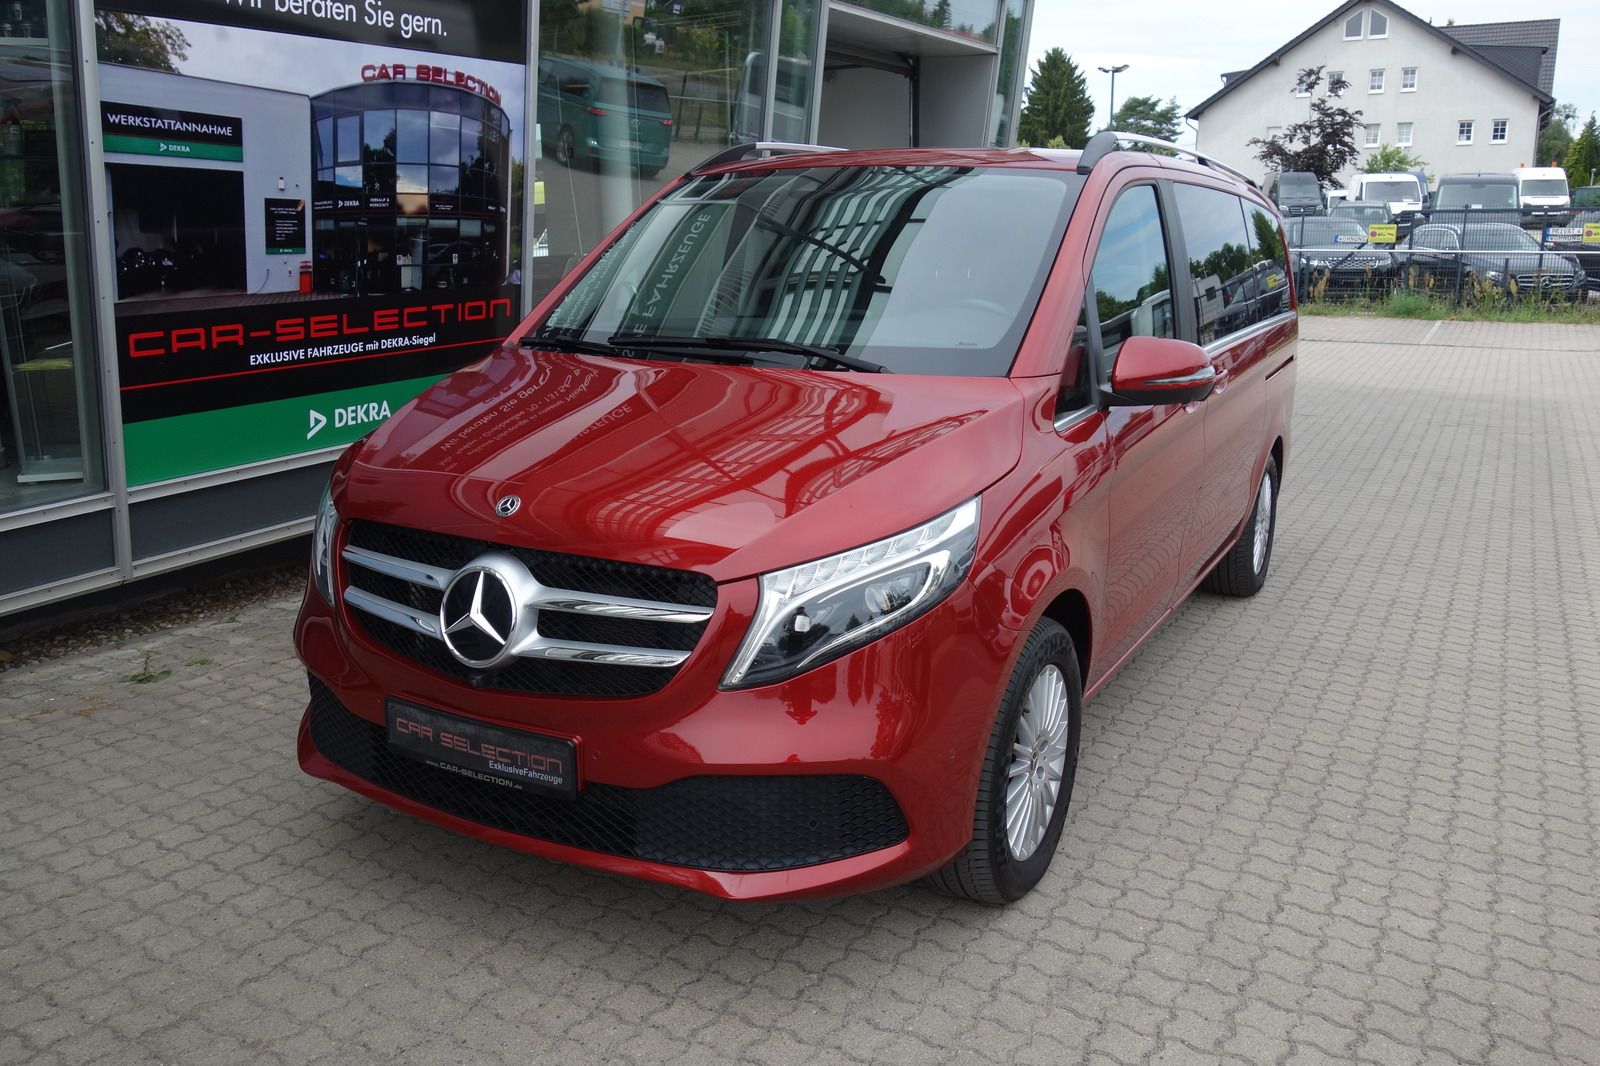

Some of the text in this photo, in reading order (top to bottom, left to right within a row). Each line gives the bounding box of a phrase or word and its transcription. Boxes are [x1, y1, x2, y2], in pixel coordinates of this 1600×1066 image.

[364, 1, 395, 28] Sie
[400, 13, 448, 39] gern.
[361, 63, 502, 106] CAR SELECTION
[107, 113, 233, 136] WERKSTATTANNAHME
[168, 144, 190, 153] DEKRA
[128, 298, 511, 358] CAR-SELECTION
[250, 332, 436, 366] EXKLUSIVE FAHRZEUGE mit DEKRA-Siegel
[334, 400, 391, 428] DEKRA
[396, 717, 563, 774] CAR SELECTION
[488, 760, 563, 785] ExklusiveFahrzeuge
